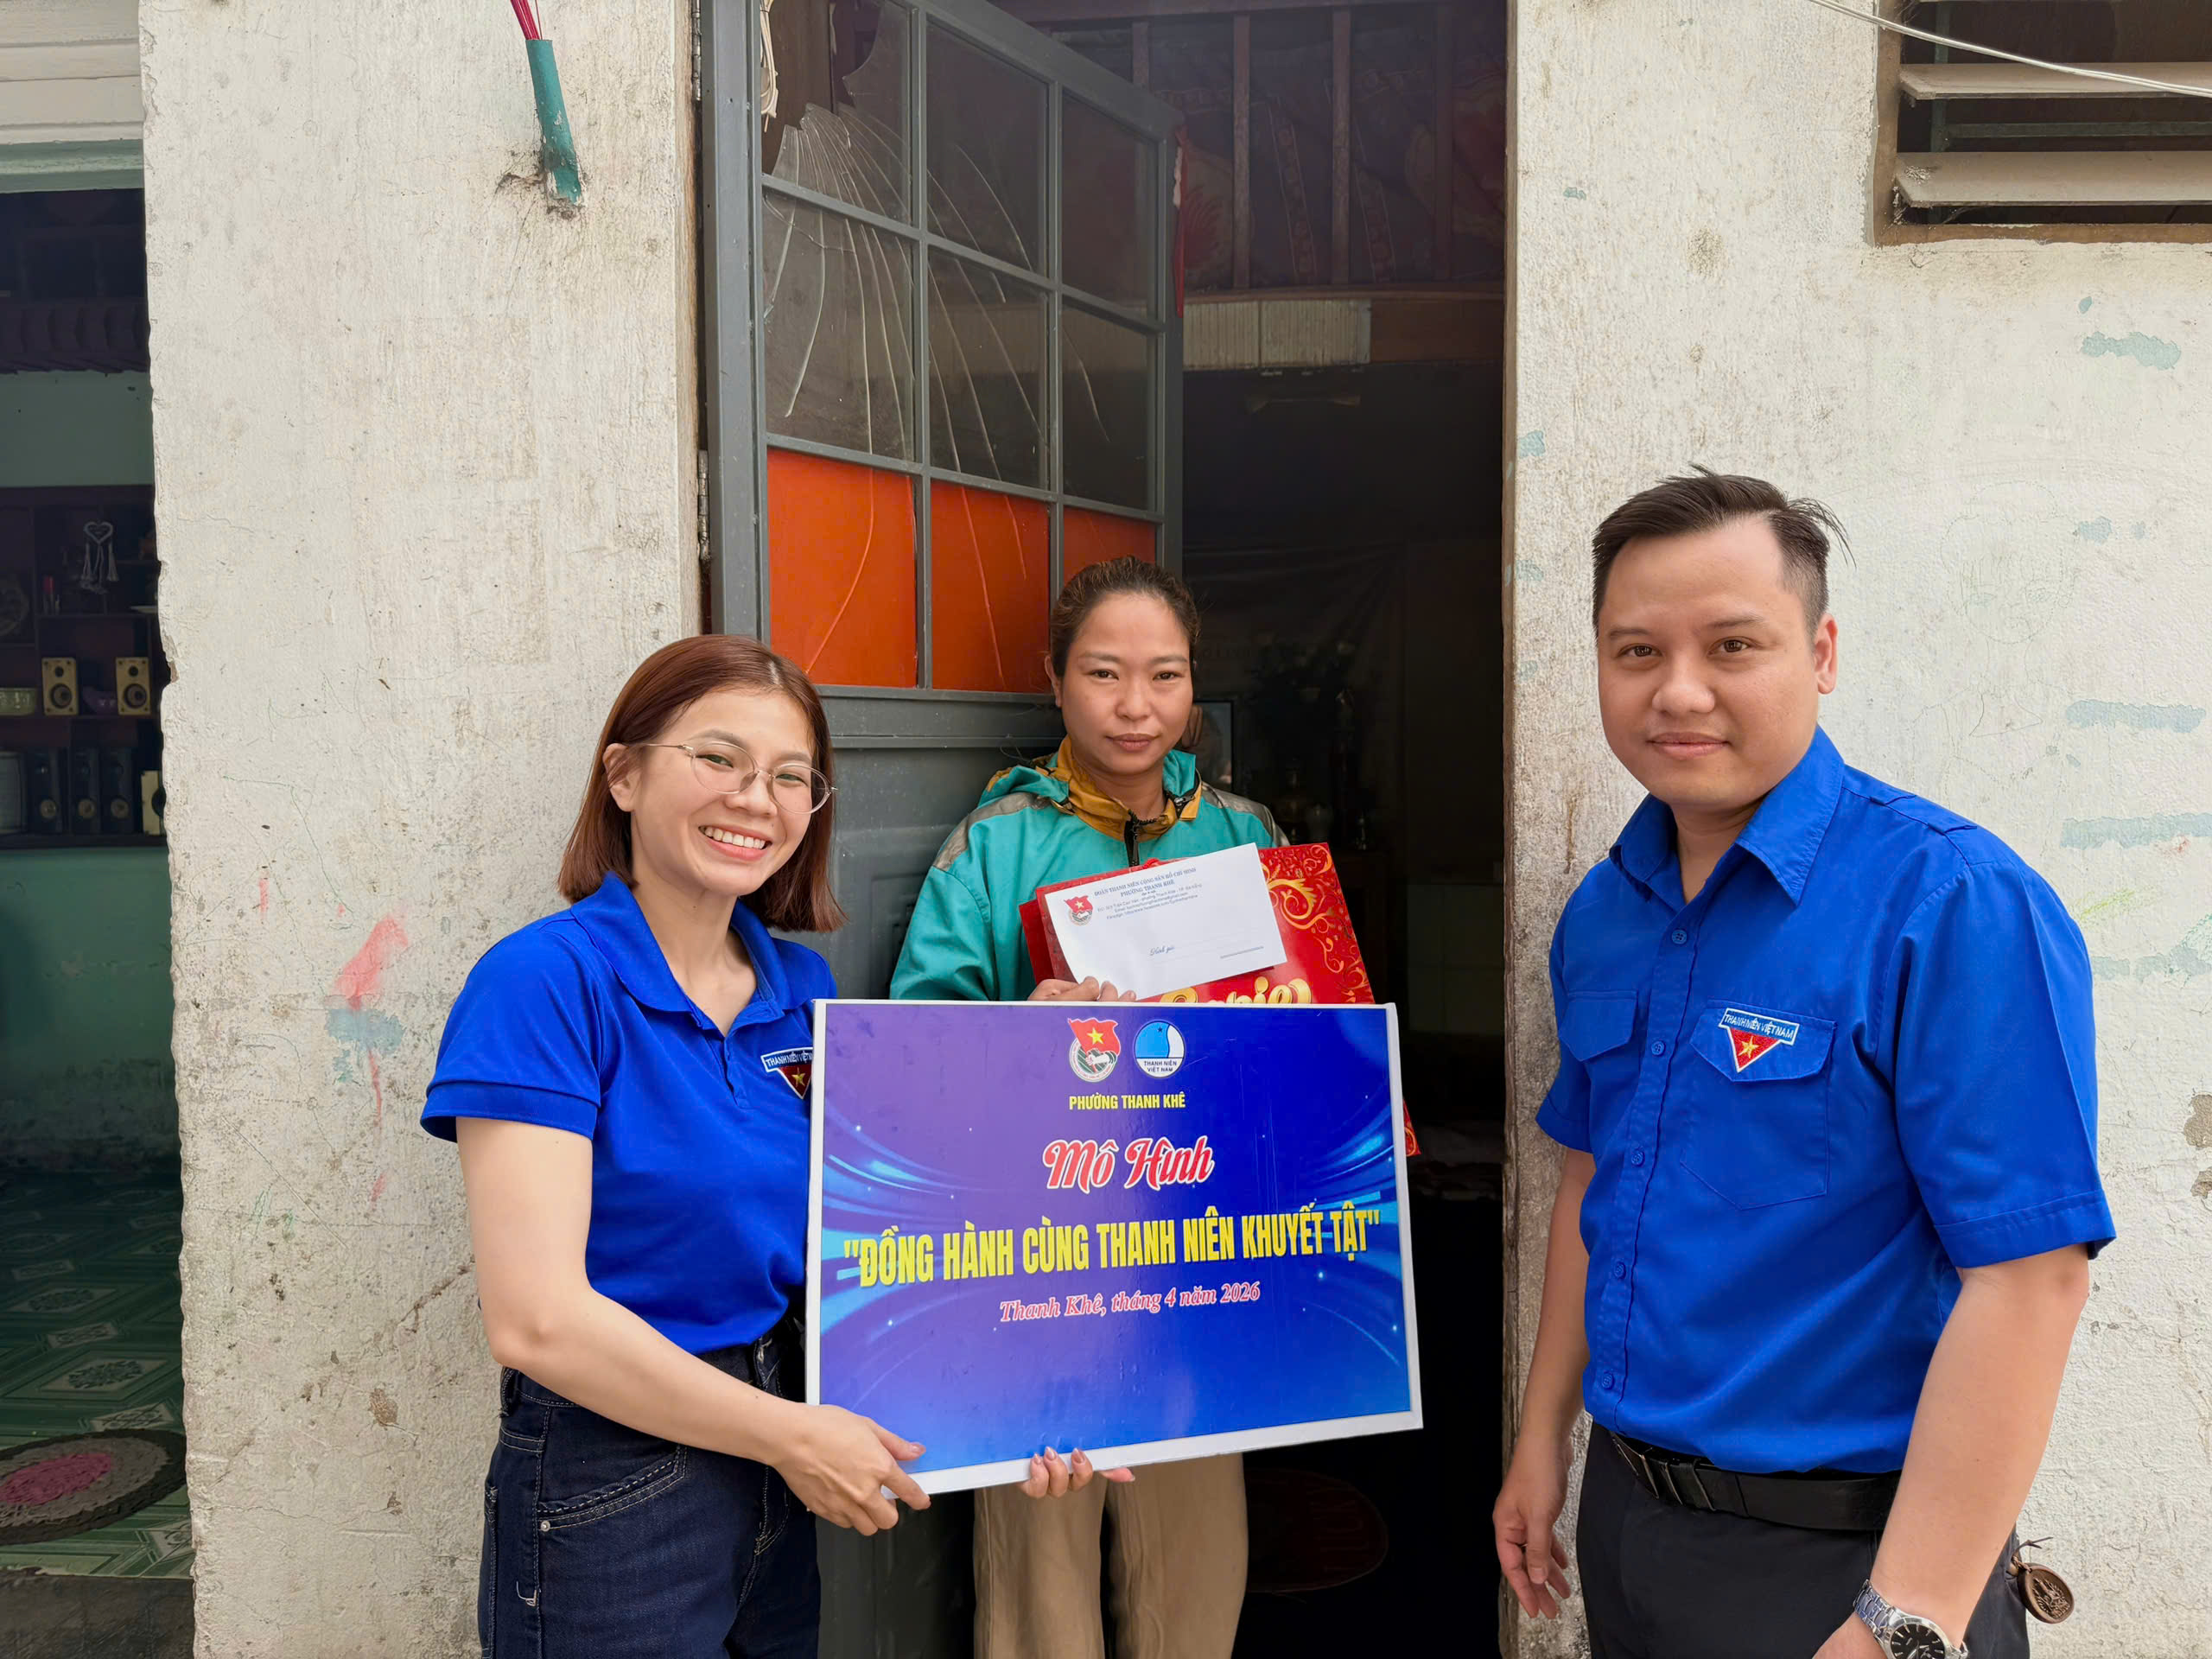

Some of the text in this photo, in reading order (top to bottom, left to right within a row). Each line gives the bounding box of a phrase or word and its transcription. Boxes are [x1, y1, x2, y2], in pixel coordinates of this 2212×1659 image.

[1724, 1014, 1795, 1039] THANH NIÊN VIỆT NAM
[1069, 1091, 1185, 1110] PHƯỜNG THANH KHÊ
[1042, 1135, 1215, 1194] Mô Hình
[843, 1200, 1380, 1287] "ĐỒNG HÀNH CÙNG THANH NIÊN KHUYẾT TẬT"
[1000, 1281, 1261, 1322] Thanh Khê, tháng 4 năm 2026
